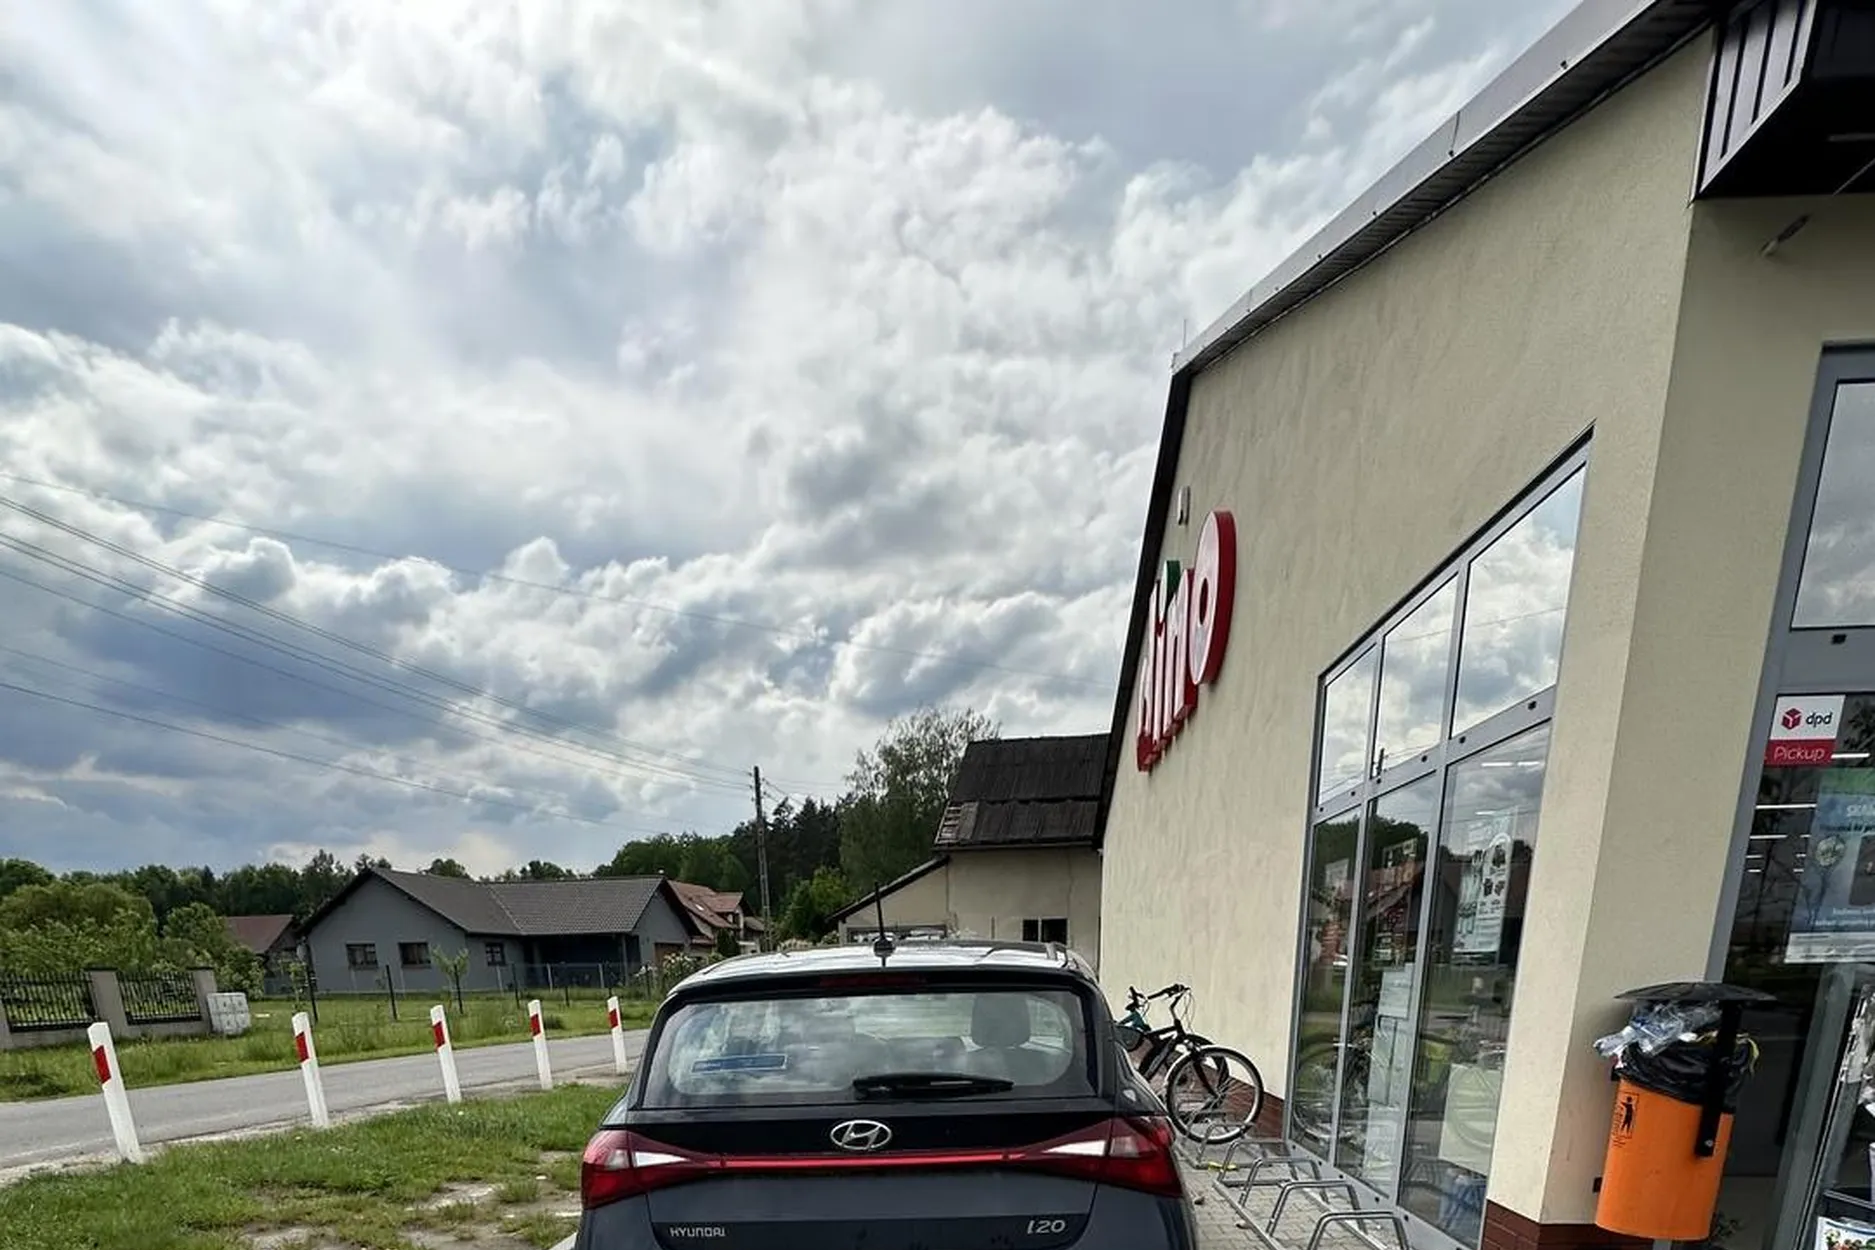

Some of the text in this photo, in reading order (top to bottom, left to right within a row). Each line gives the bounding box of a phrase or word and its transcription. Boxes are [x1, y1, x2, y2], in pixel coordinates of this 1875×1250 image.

[1805, 711, 1833, 728] dpd
[1773, 745, 1826, 762] Pickup
[669, 1226, 726, 1238] HYUNDAI
